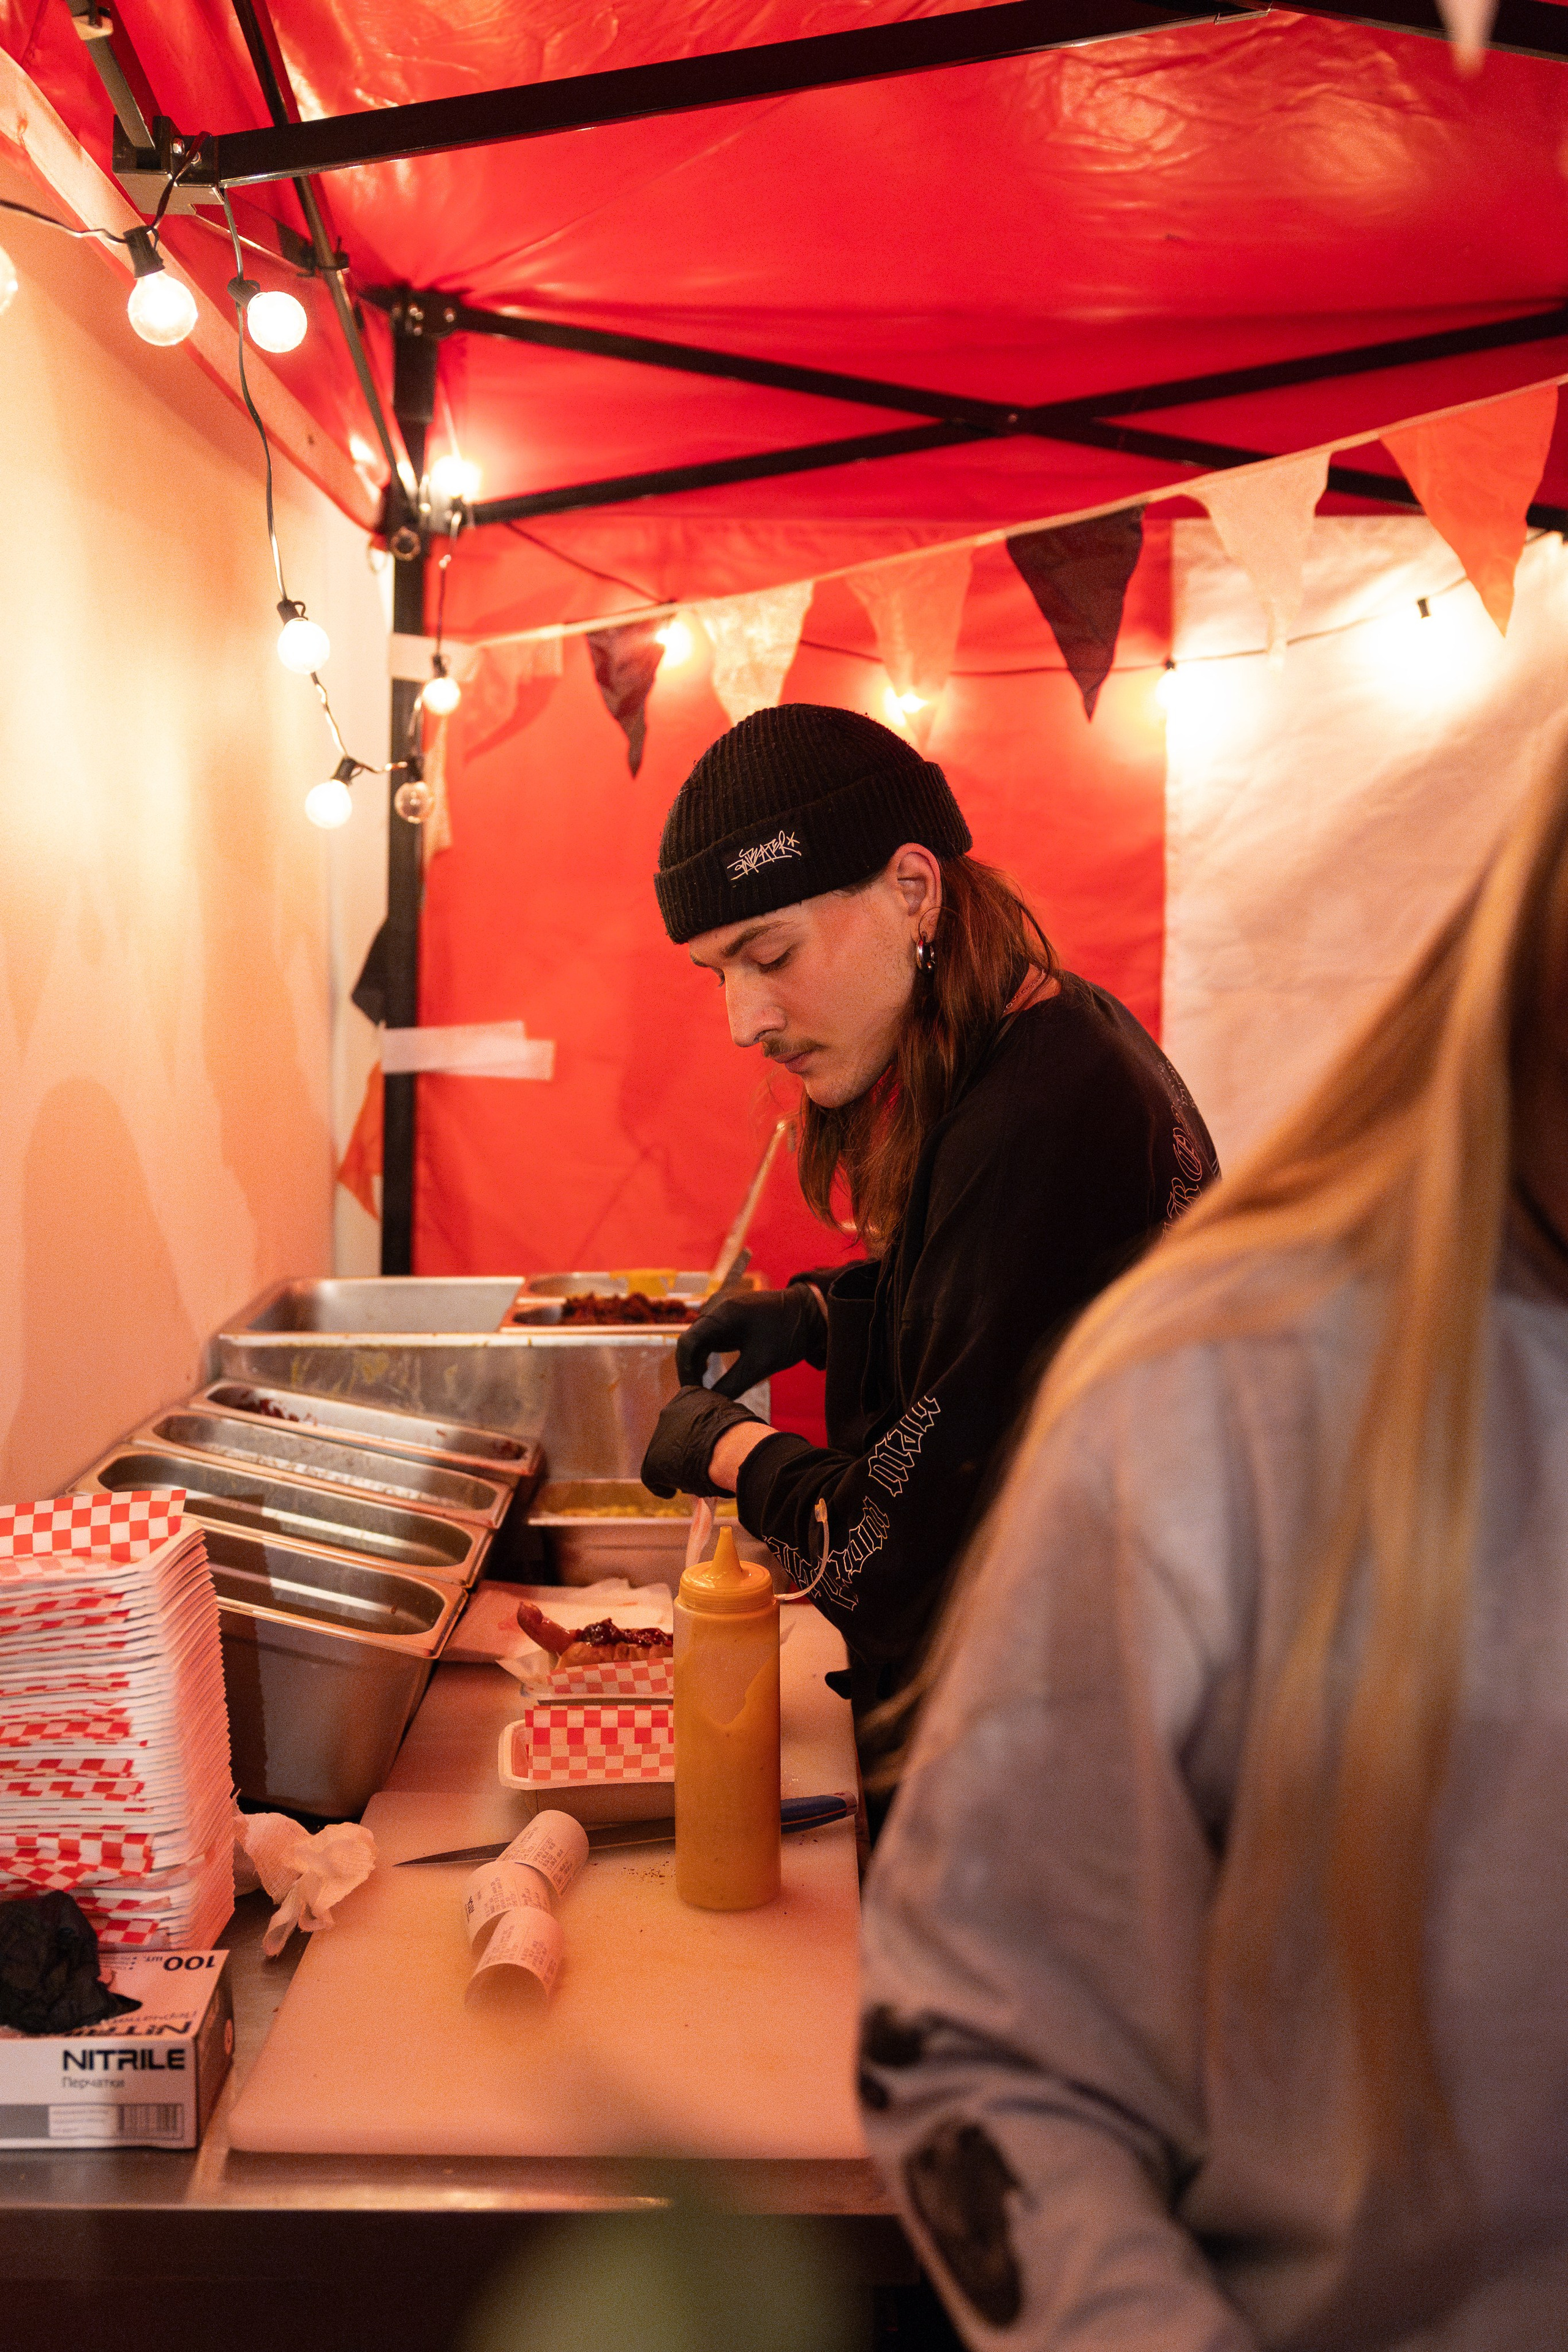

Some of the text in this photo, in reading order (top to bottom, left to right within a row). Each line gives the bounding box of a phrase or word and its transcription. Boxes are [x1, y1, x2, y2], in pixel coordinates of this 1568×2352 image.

[164, 1956, 214, 1971] 100
[62, 2049, 185, 2071] NITRILE
[62, 2076, 125, 2089] Перчатки
